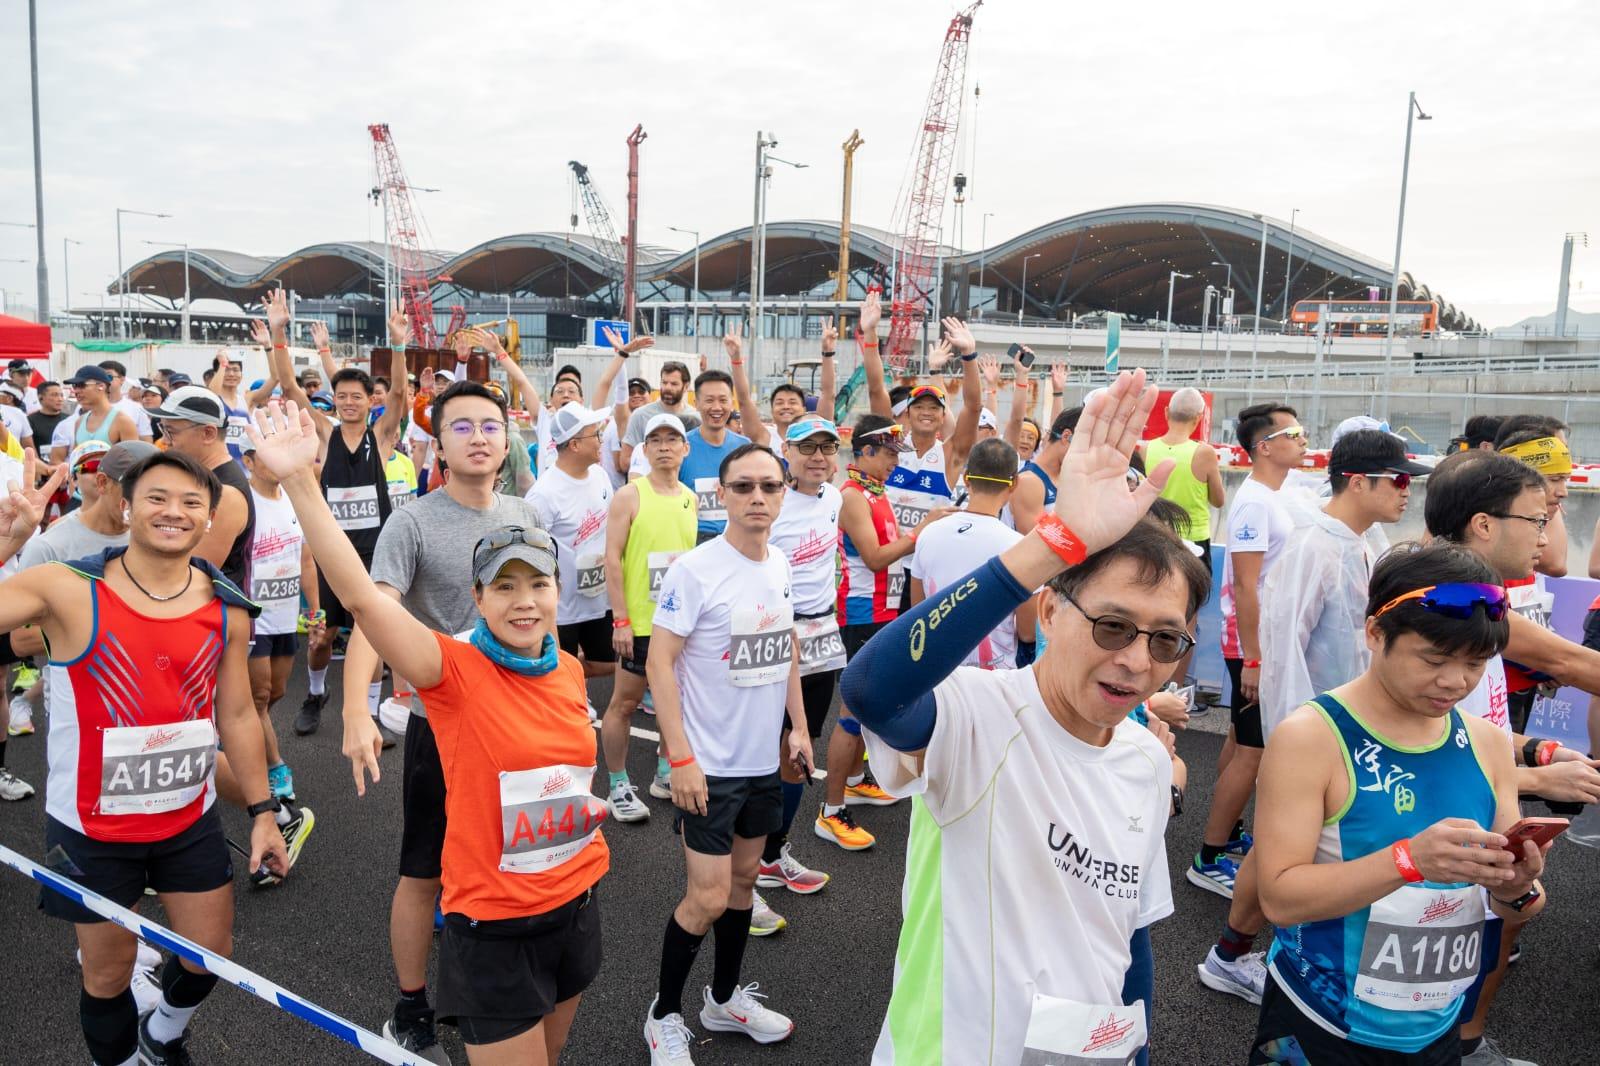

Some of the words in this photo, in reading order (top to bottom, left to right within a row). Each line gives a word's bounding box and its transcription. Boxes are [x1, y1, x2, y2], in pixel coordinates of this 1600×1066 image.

[330, 501, 377, 518] A1846
[699, 492, 725, 510] A1
[257, 578, 300, 599] A2365
[928, 577, 979, 630] asics
[733, 633, 792, 665] A1612
[107, 751, 208, 791] A1541
[1047, 822, 1140, 884] UNIERSE
[1104, 883, 1139, 899] CLUB
[1370, 930, 1480, 975] A1180
